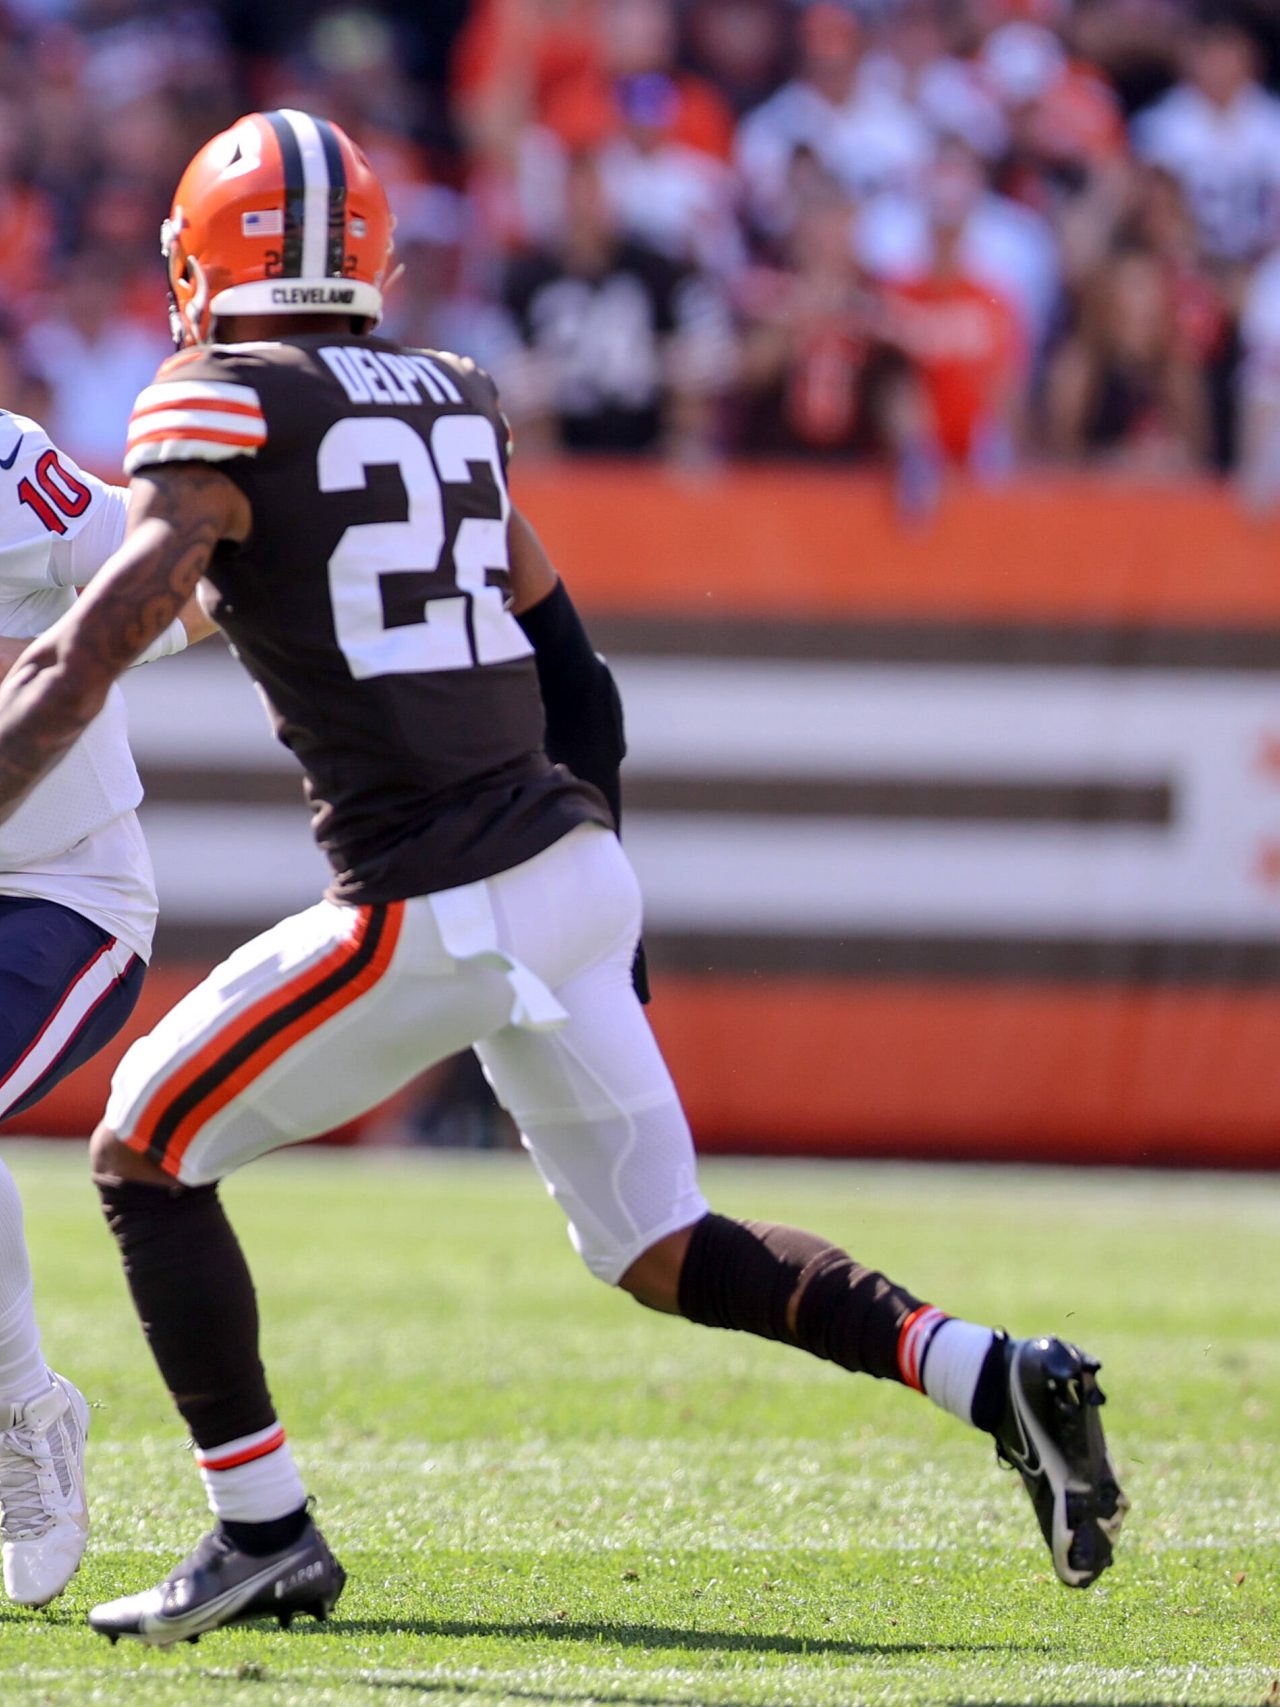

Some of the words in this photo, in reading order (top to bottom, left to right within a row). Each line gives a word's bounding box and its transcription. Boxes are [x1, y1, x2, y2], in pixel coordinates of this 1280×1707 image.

[271, 287, 355, 304] CLEVELAND
[317, 345, 462, 405] DELPIT
[16, 448, 92, 536] 10
[316, 414, 536, 681] 22
